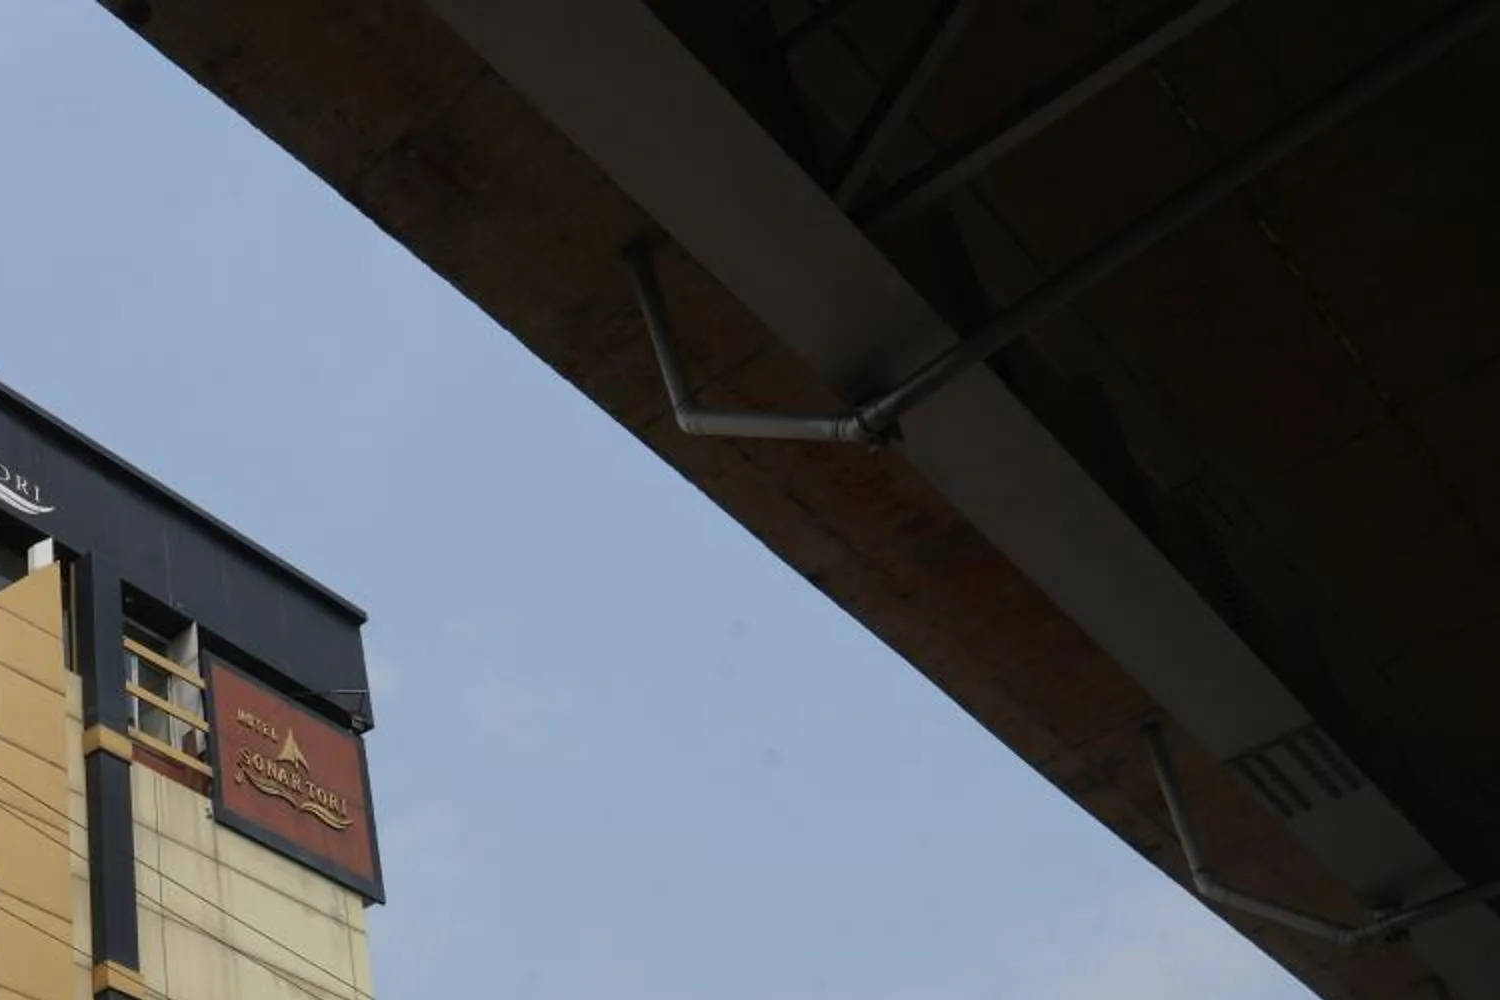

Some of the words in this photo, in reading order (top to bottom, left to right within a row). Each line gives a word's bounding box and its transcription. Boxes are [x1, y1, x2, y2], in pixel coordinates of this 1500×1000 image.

[237, 707, 278, 742] HOTEL
[241, 748, 303, 794] SONAR
[305, 780, 347, 817] TORI
